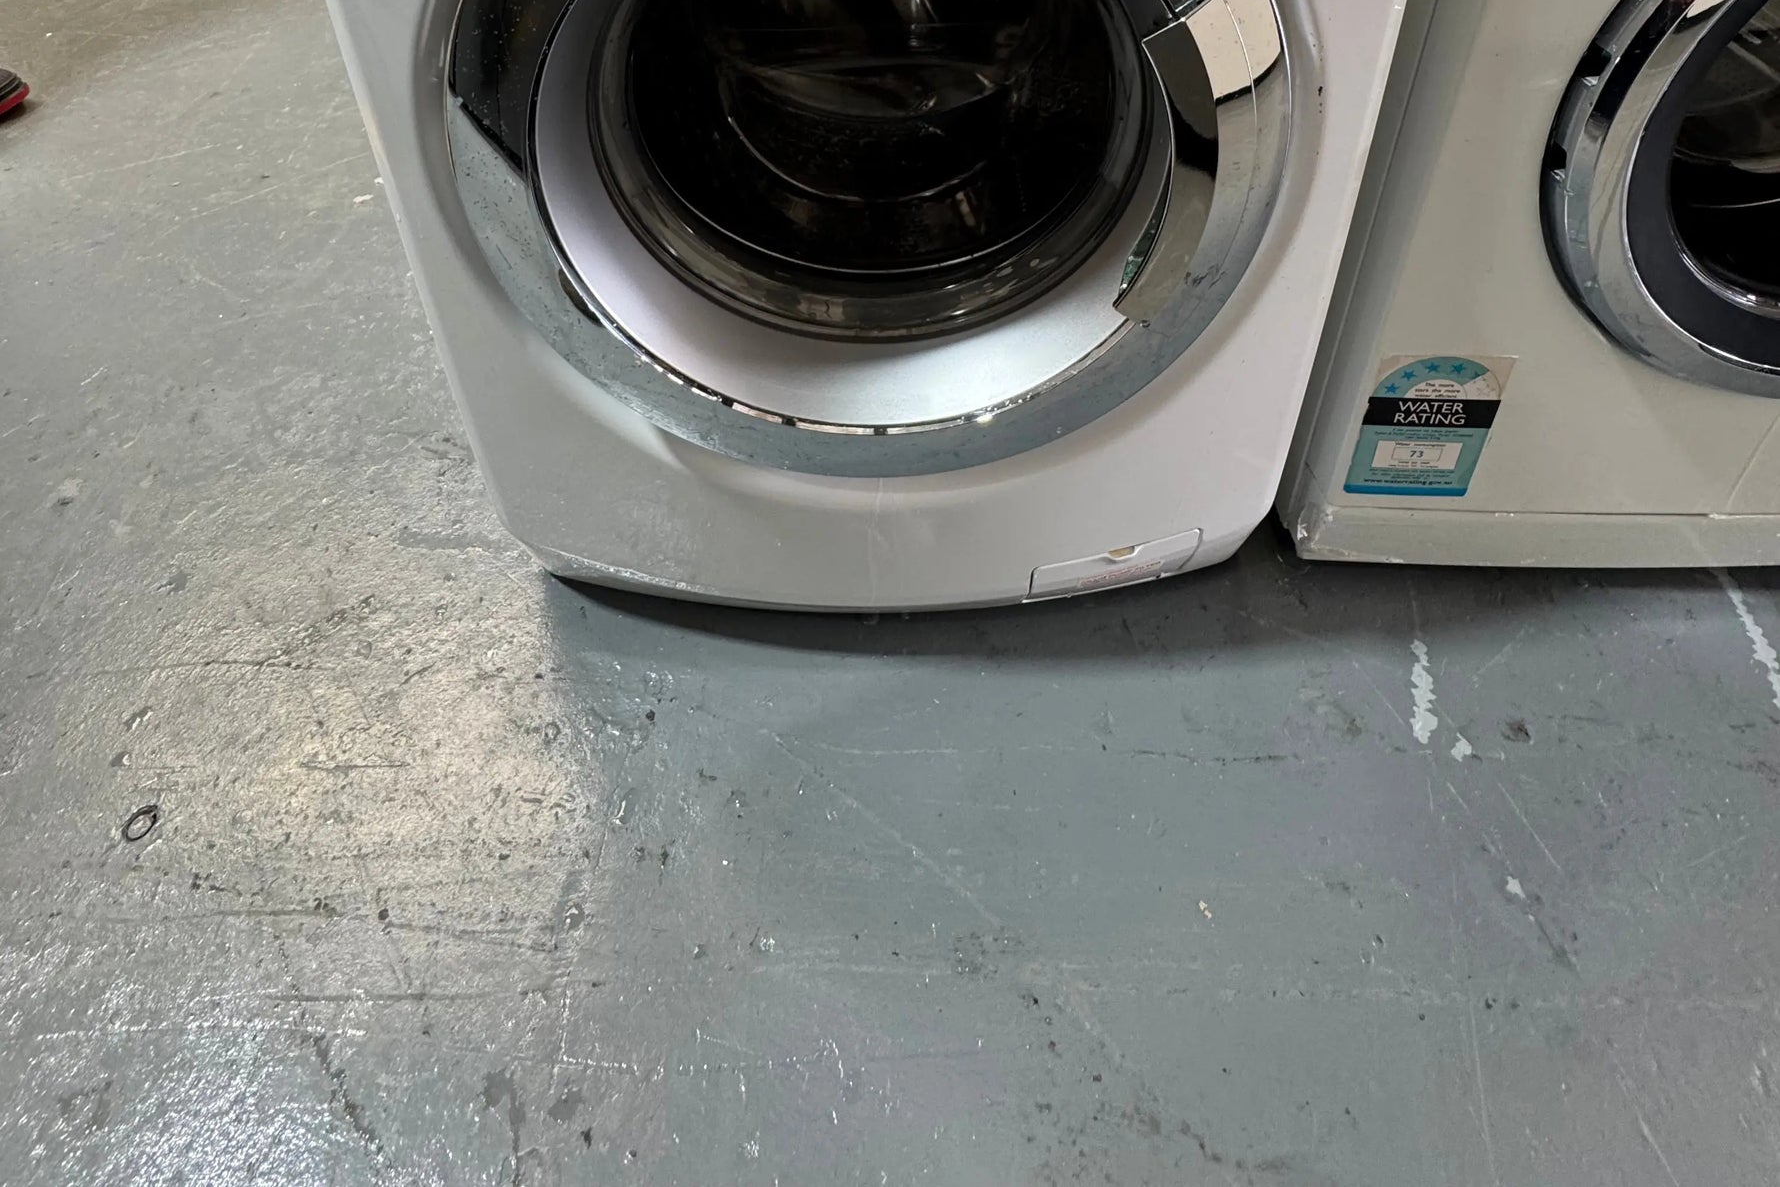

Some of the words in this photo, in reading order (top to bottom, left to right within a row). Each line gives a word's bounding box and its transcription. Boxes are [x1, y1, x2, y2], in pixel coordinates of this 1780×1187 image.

[1399, 401, 1464, 414] WATER
[1393, 413, 1466, 425] RATING
[1410, 450, 1424, 458] 73
